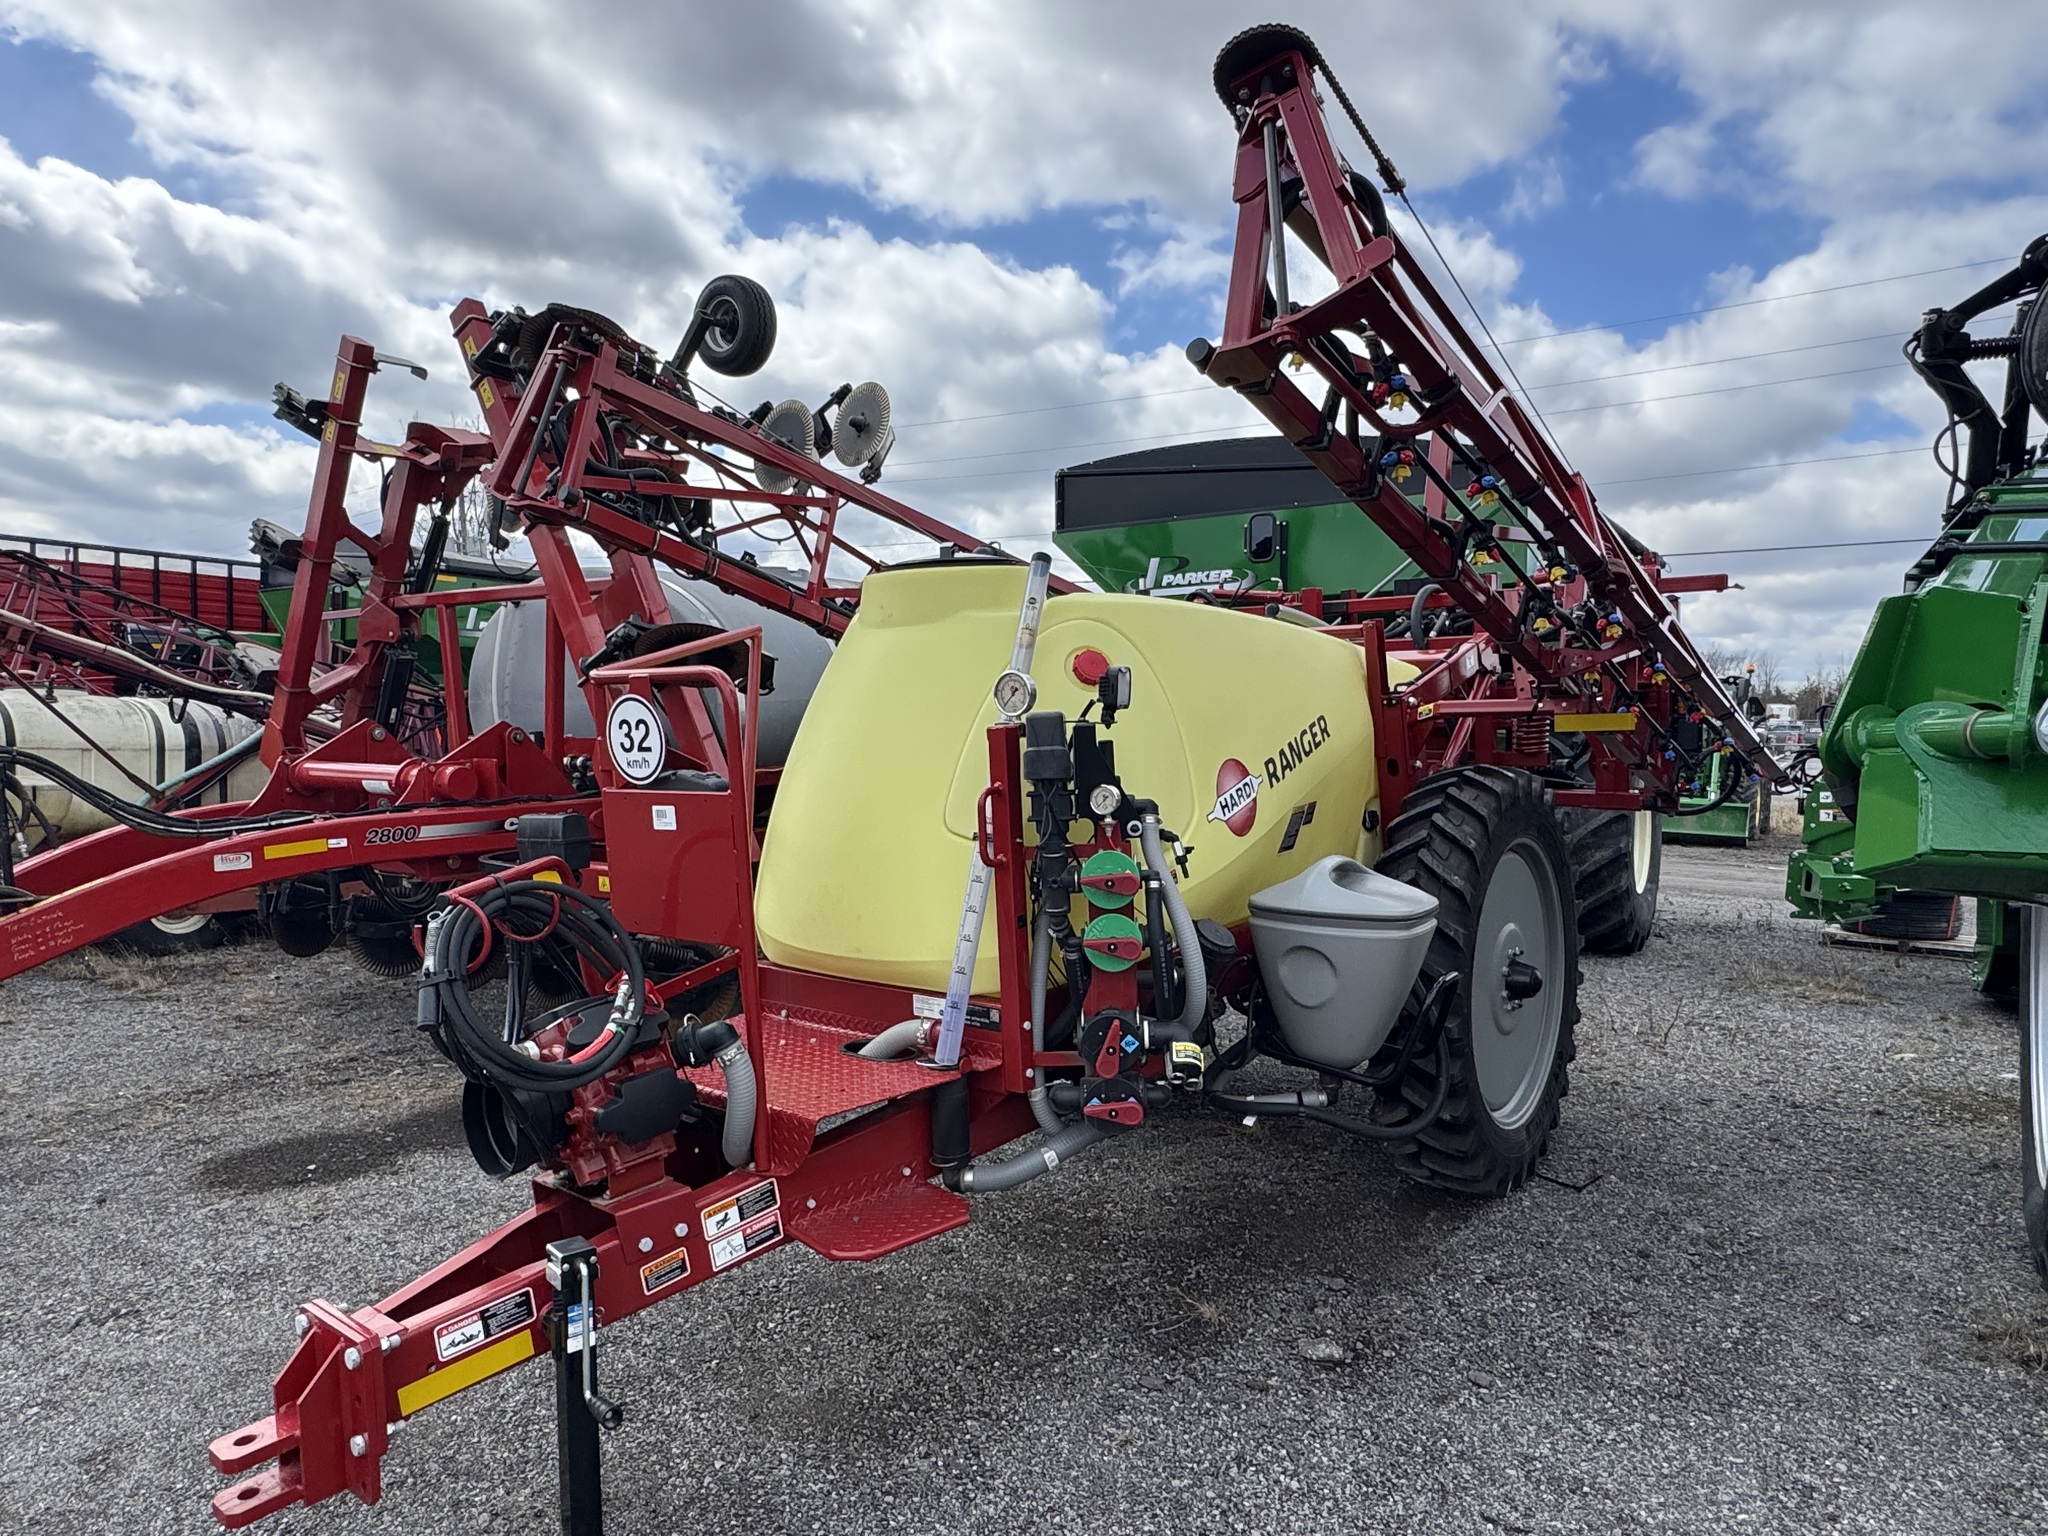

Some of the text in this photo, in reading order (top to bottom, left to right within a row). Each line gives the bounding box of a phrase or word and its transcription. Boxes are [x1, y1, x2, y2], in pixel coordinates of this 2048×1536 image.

[1161, 569, 1234, 587] PARKER
[618, 718, 653, 753] 32
[626, 757, 651, 769] km/h
[1219, 778, 1256, 817] HARDI
[1263, 714, 1331, 789] RANGER
[364, 825, 419, 846] 2800
[653, 1252, 681, 1270] WARNING
[447, 1314, 479, 1333] DANGER
